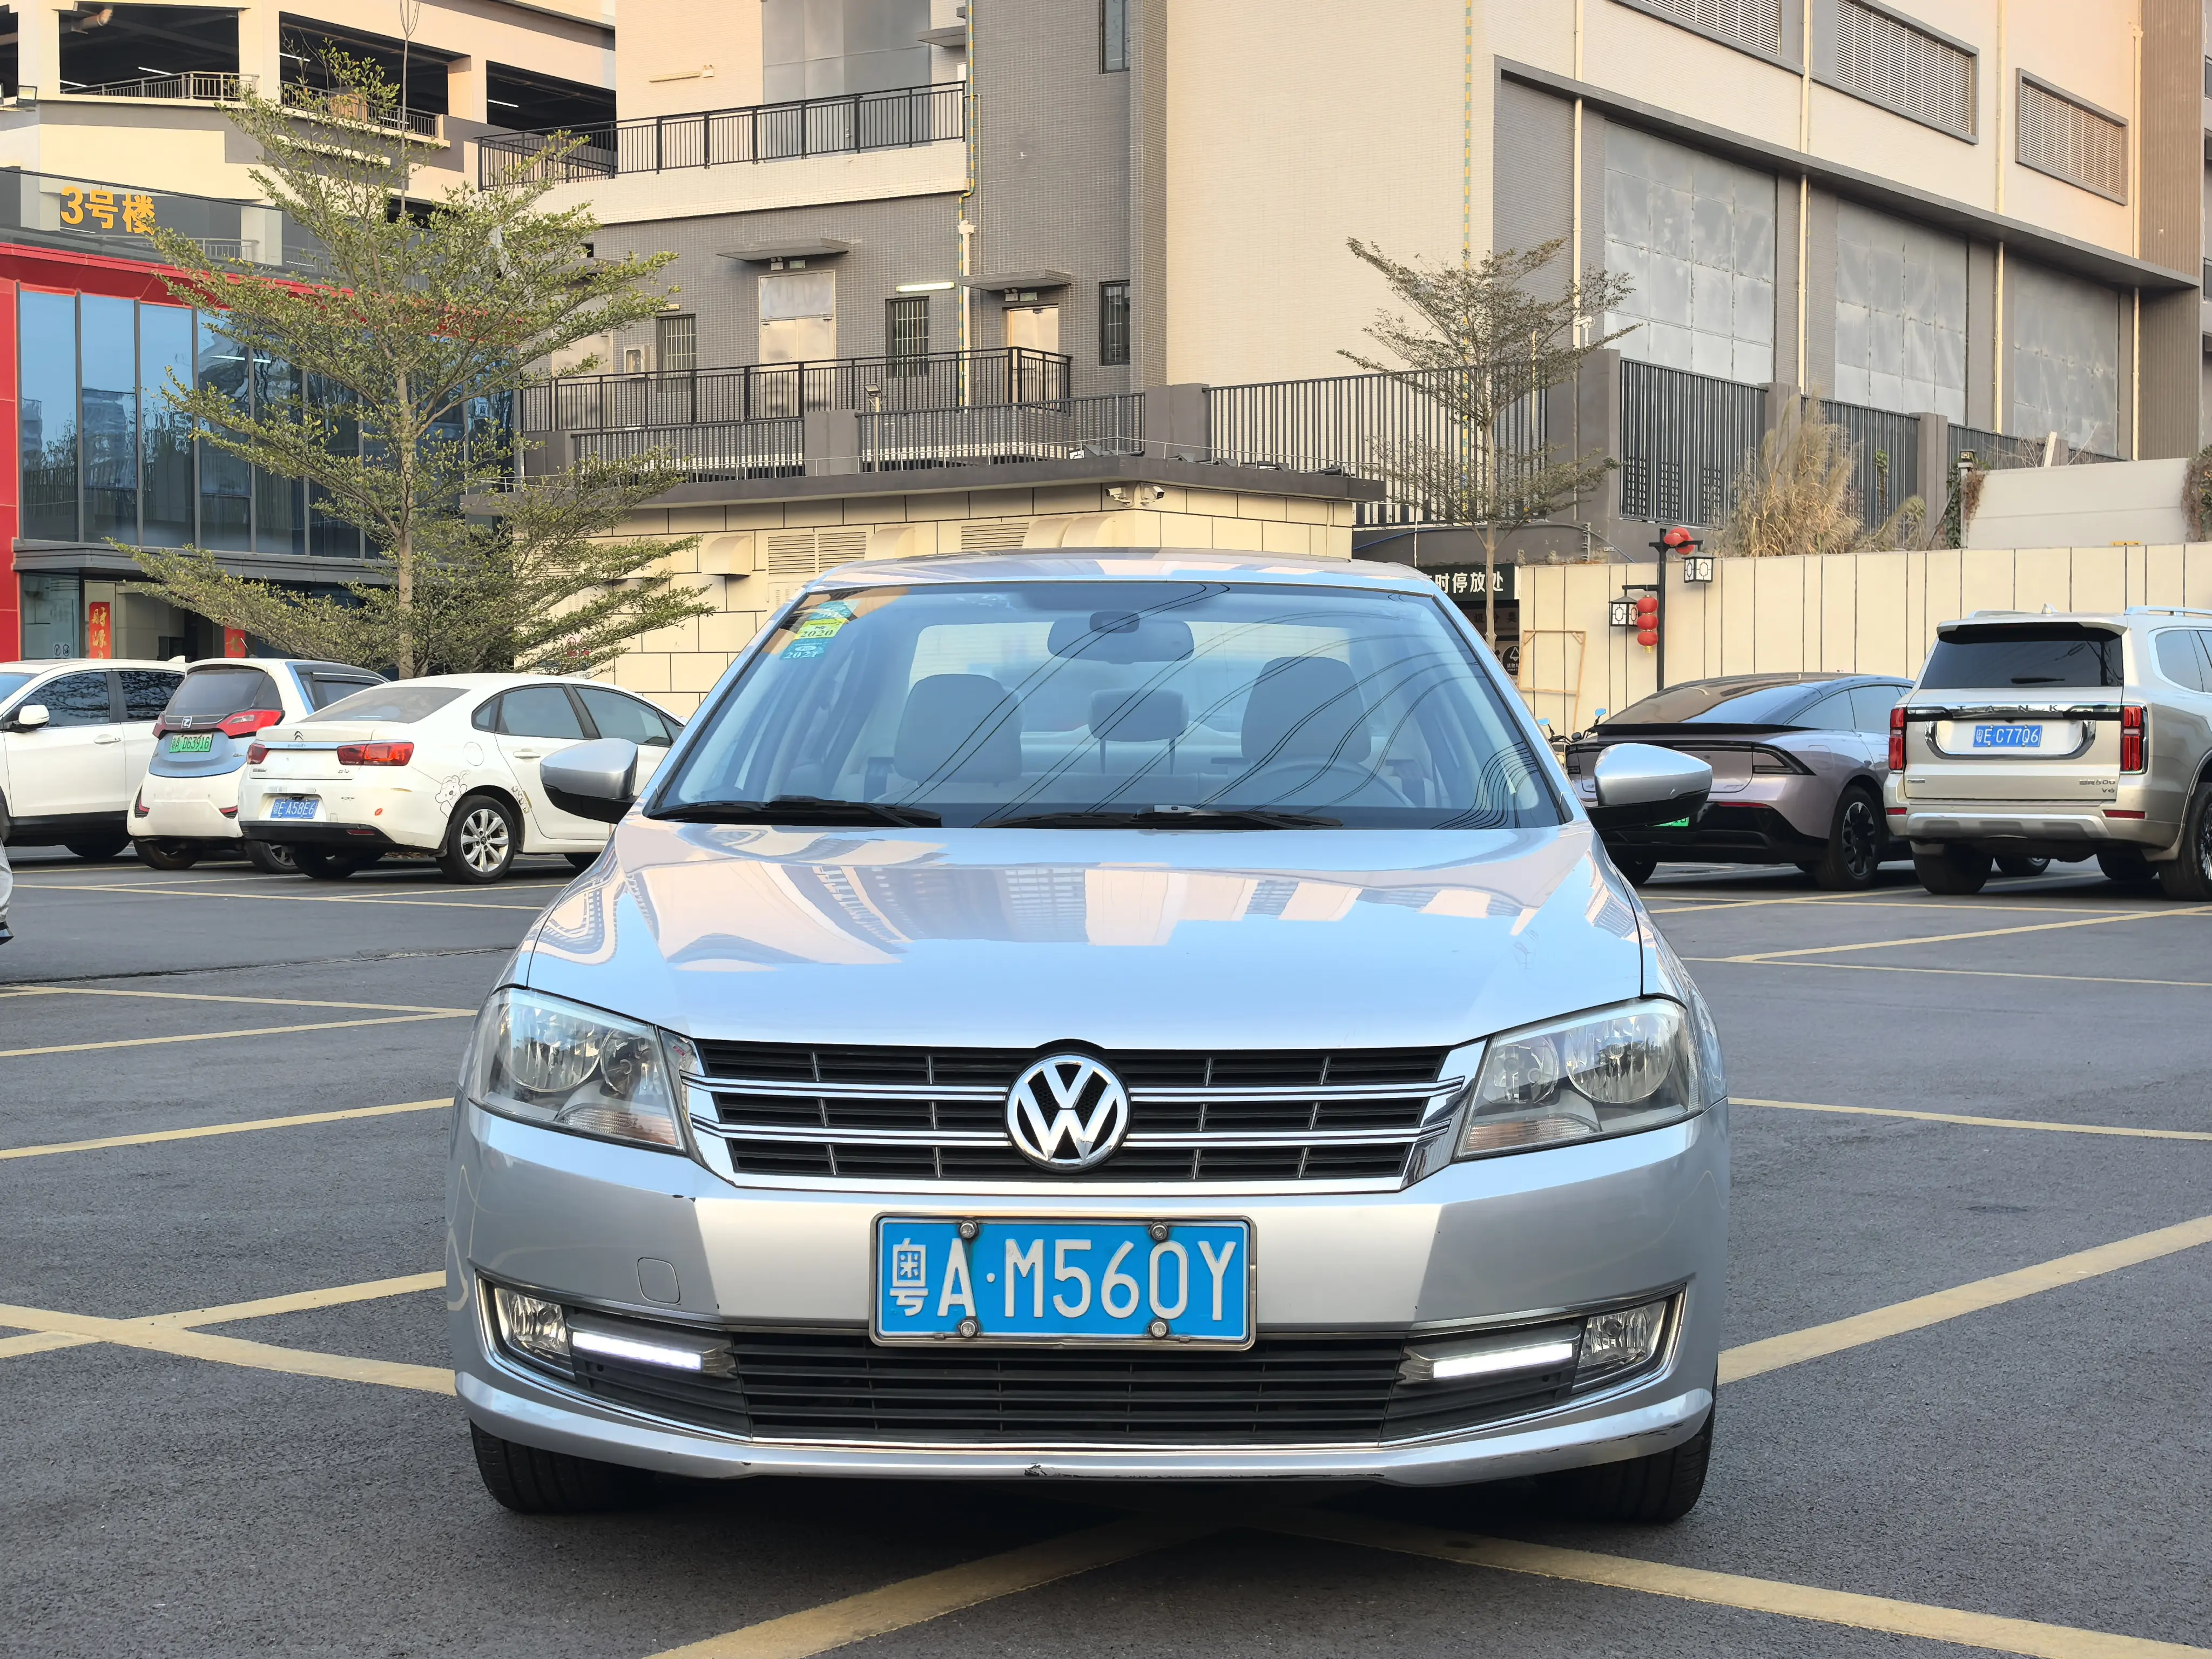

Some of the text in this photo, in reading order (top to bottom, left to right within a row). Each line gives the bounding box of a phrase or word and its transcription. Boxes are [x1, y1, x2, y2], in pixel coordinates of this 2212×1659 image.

[60, 186, 155, 235] 3号楼
[1426, 571, 1503, 594] 时停放处
[799, 629, 834, 638] 2020
[1957, 704, 2058, 713] TANK
[889, 1237, 1236, 1320] 粤A·M560Y
